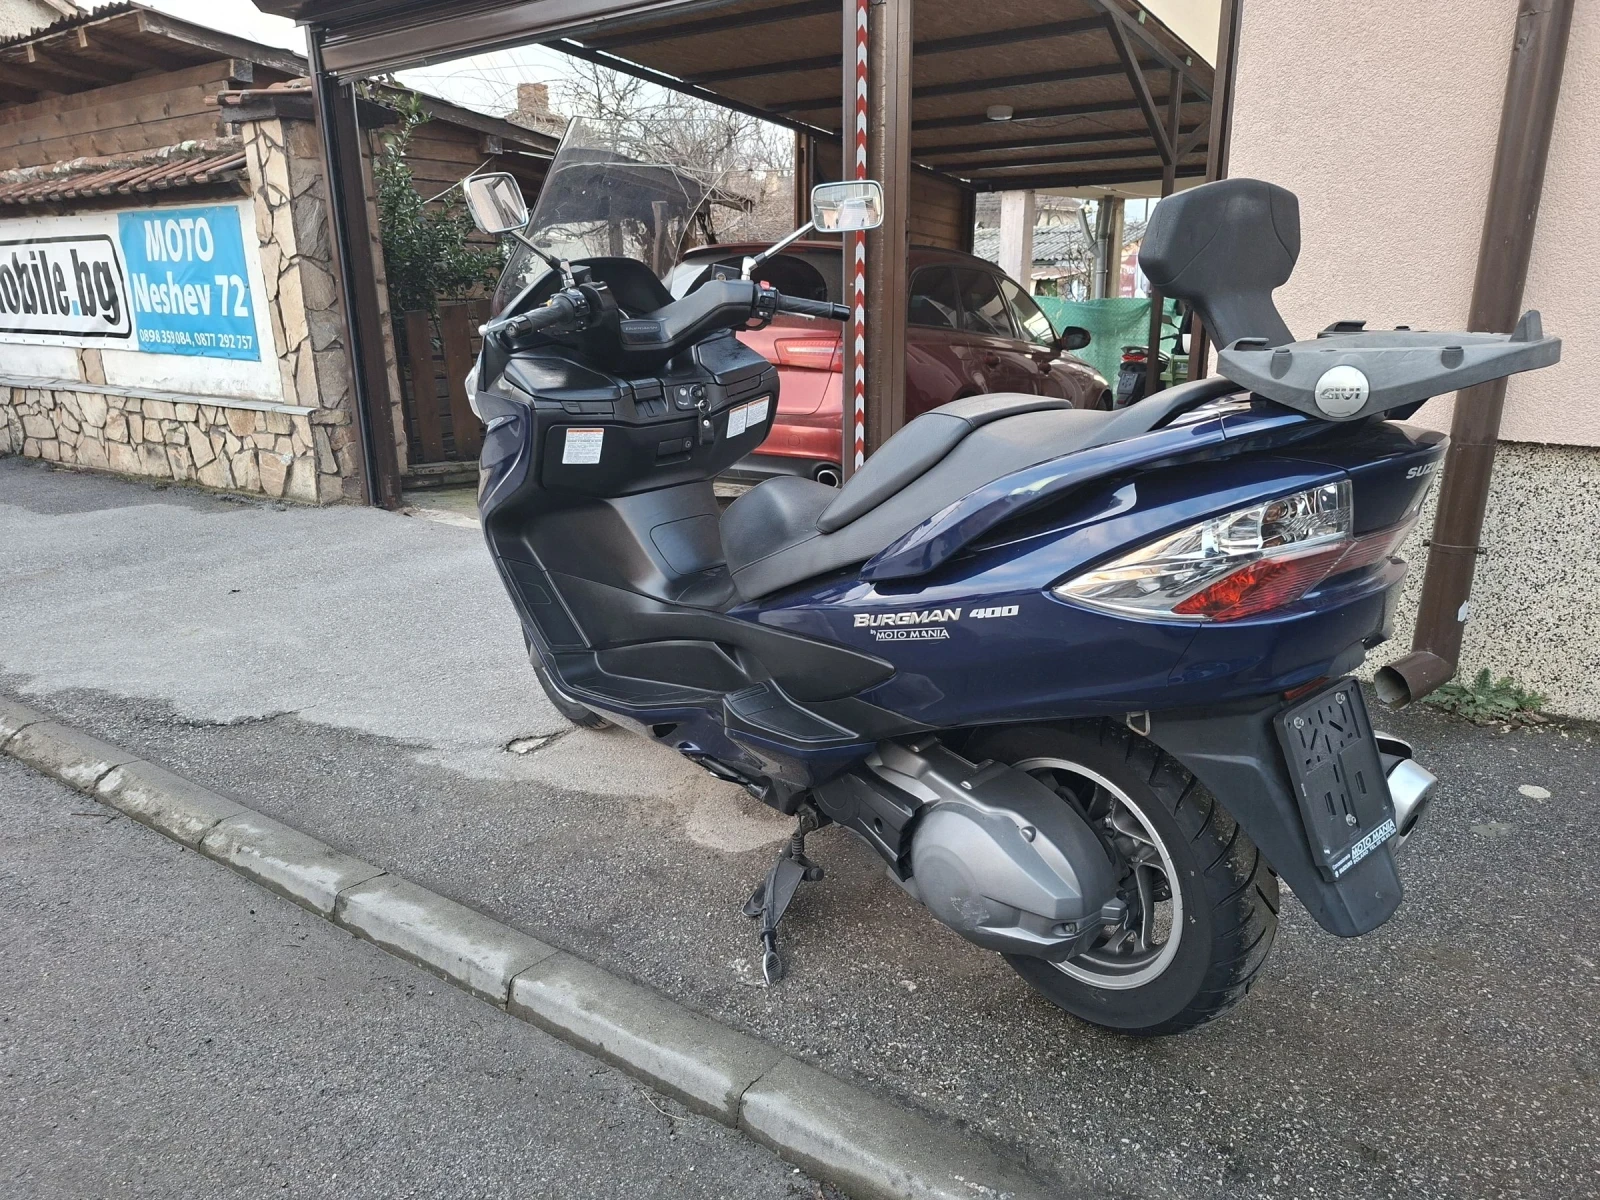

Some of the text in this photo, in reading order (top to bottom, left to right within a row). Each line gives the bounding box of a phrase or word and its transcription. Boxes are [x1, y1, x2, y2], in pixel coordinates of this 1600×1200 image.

[144, 216, 214, 262] MOTO
[132, 271, 249, 317] Neshev 72
[140, 329, 161, 343] 0898
[194, 332, 216, 347] 0877
[218, 333, 236, 349] 292
[237, 335, 252, 350] 757
[1320, 387, 1361, 400] GIVI
[853, 604, 1020, 627] BURGMAN 400
[876, 628, 950, 641] MOTO MANIA
[1352, 837, 1371, 860] MOTO
[1373, 818, 1396, 842] MANIA
